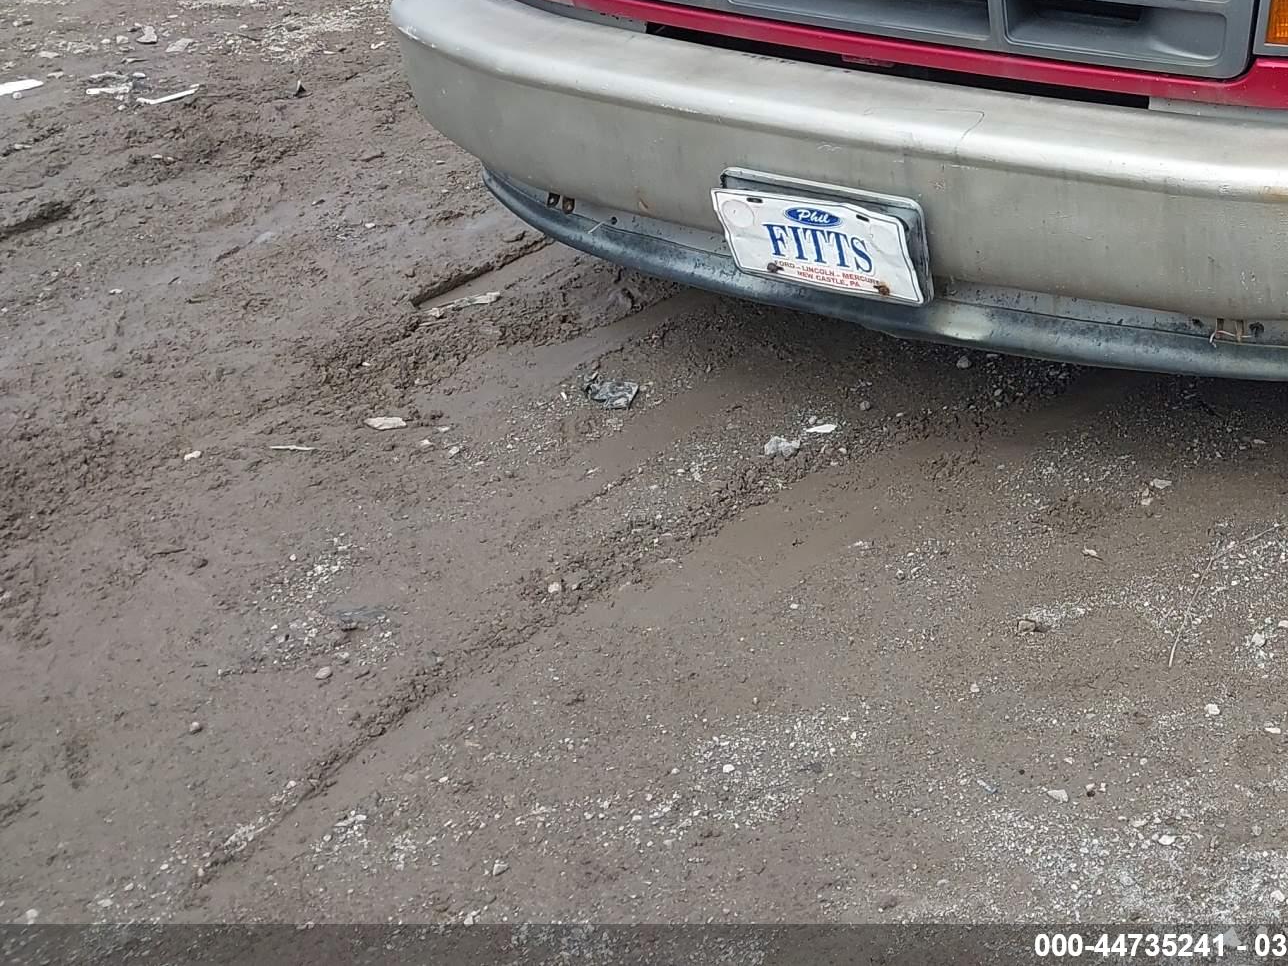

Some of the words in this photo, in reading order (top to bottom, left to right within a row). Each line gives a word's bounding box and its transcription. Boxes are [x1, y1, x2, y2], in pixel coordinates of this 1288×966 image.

[796, 209, 831, 224] Phil
[763, 223, 873, 273] FITTS
[774, 260, 795, 269] FORD
[801, 265, 835, 277] LINCOLN
[797, 270, 814, 280] NEW
[849, 280, 861, 288] PA
